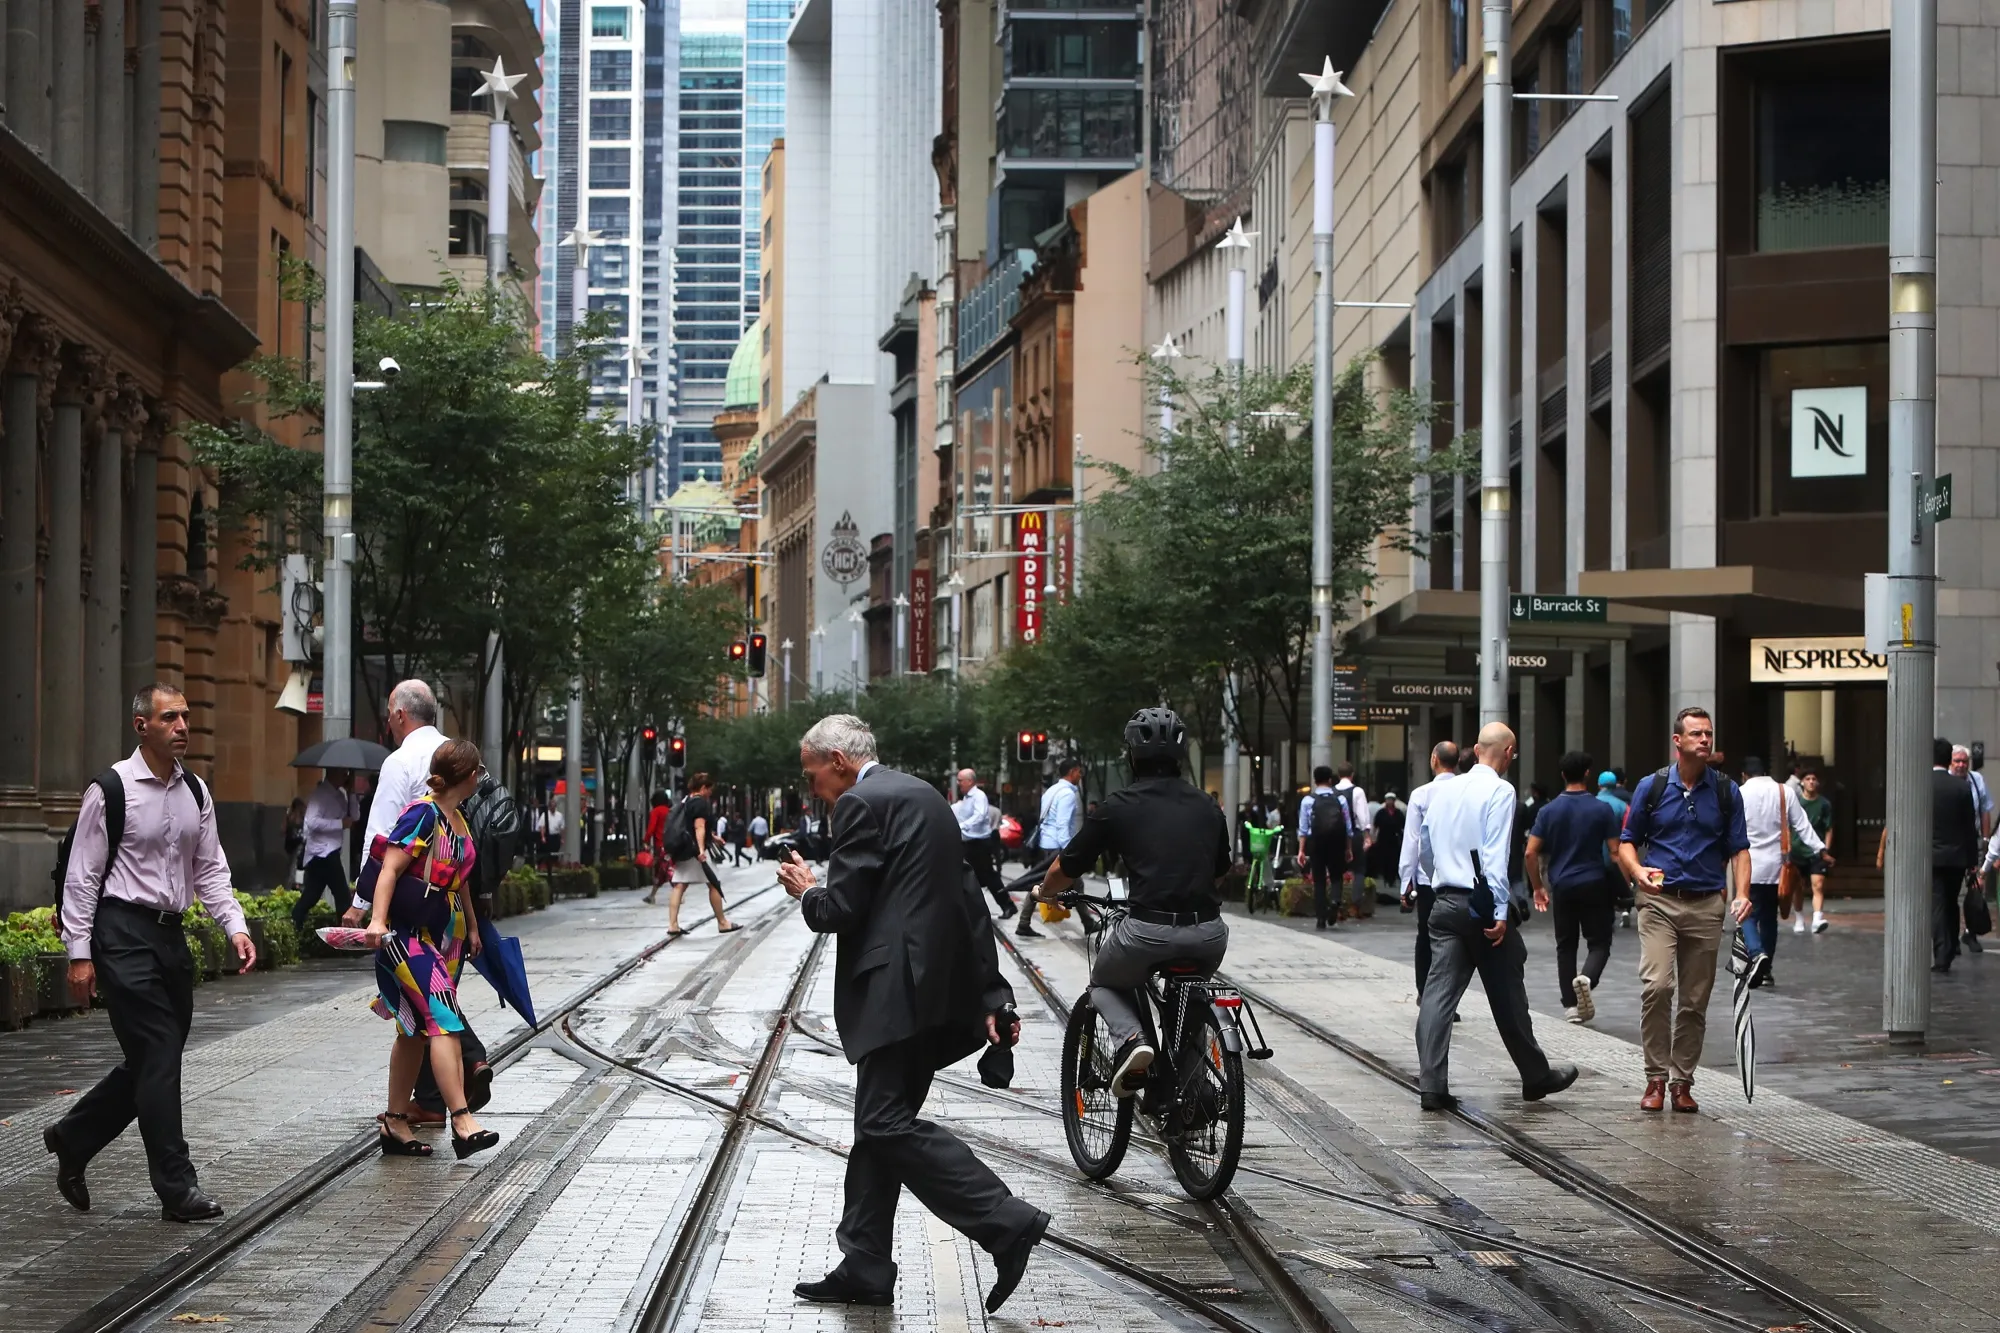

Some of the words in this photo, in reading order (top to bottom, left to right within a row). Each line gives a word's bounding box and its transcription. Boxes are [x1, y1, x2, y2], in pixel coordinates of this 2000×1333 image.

[1803, 406, 1855, 458] N
[1924, 492, 1942, 515] George
[1533, 598, 1583, 612] Barrack
[1586, 599, 1600, 612] St
[1761, 646, 1888, 674] NESPRESSO
[1392, 685, 1431, 695] GEORG
[1433, 686, 1473, 696] JENSEN
